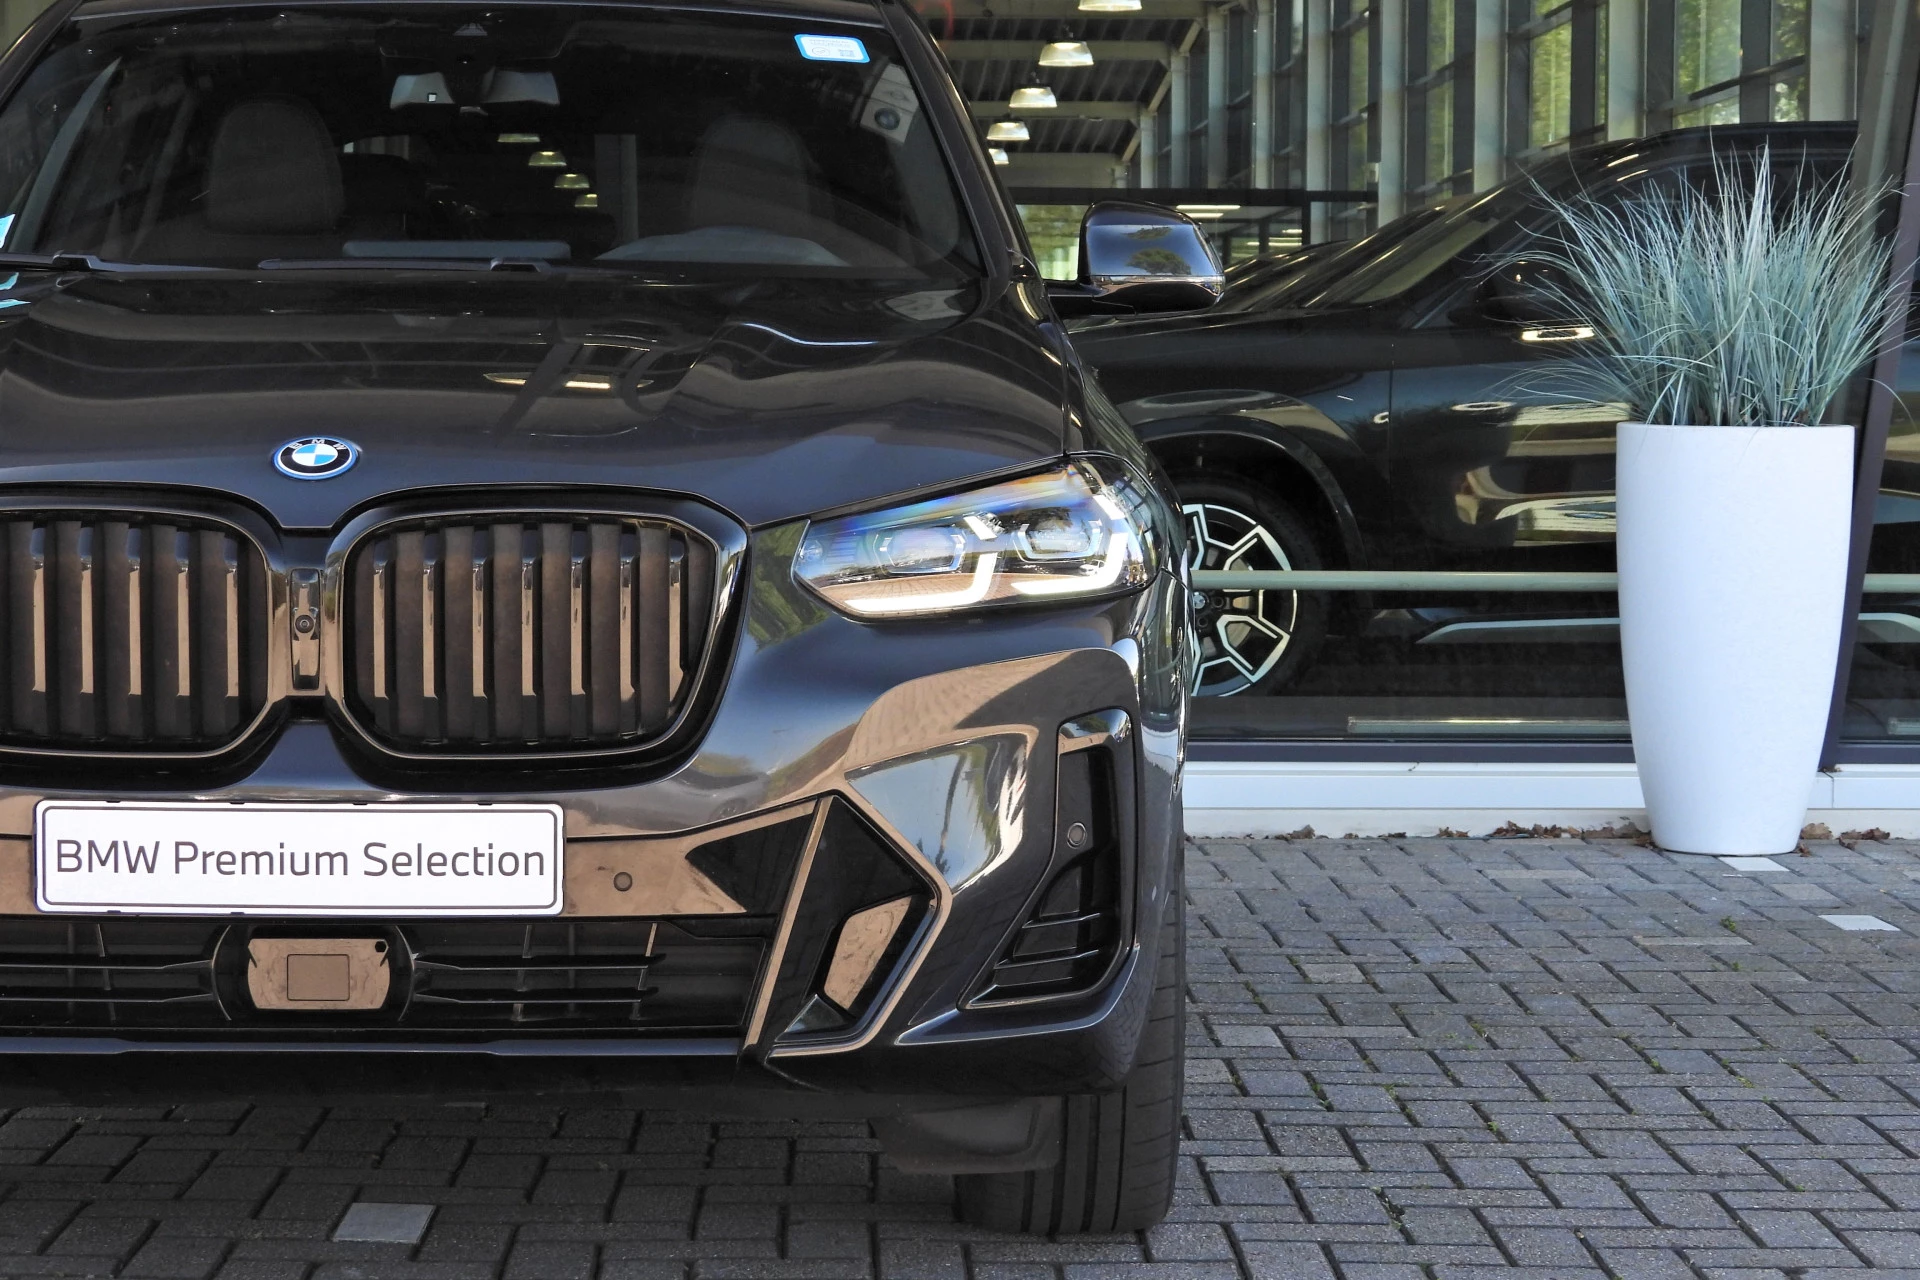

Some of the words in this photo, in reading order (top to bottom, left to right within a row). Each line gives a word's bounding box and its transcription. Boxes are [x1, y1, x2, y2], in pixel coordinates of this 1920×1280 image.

[288, 438, 347, 450] BMW
[56, 839, 160, 874] BMW
[174, 841, 349, 877] Premium
[363, 842, 545, 877] Selection
